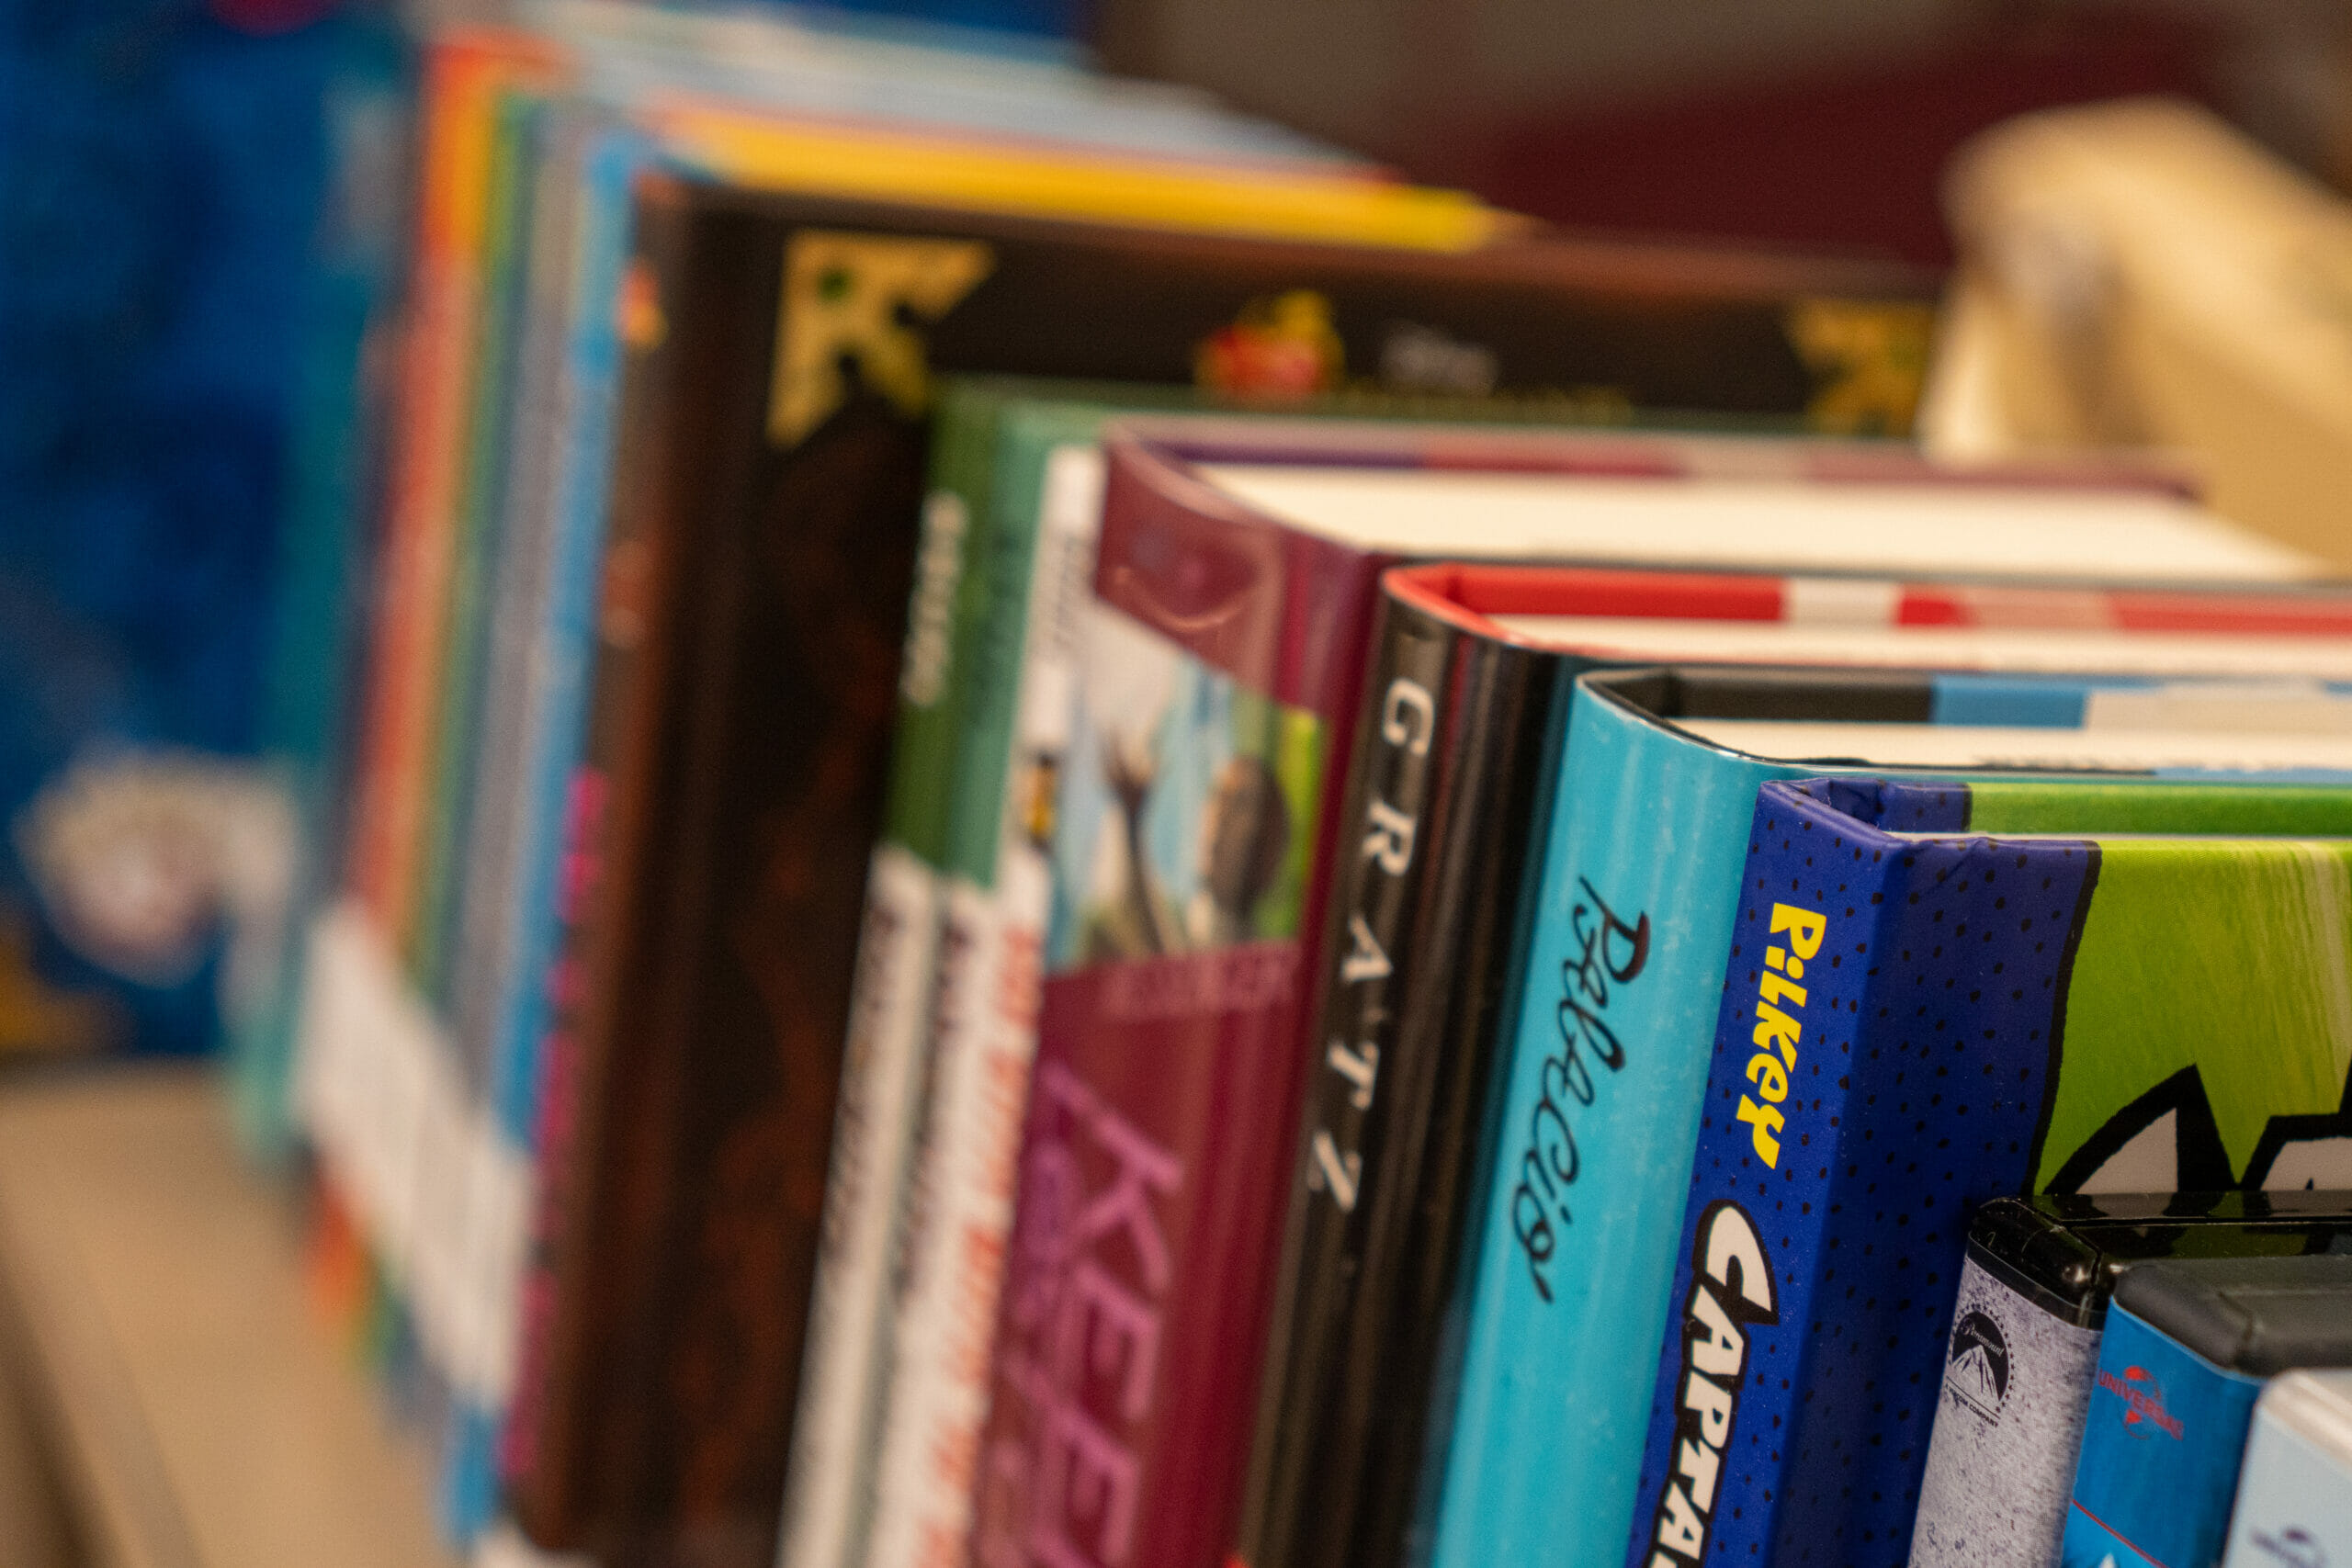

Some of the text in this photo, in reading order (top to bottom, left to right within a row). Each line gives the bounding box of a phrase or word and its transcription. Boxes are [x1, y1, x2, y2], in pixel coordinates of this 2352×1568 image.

[1307, 676, 1435, 1213] GRATZ
[1511, 875, 1651, 1304] Palacio
[1648, 1203, 1774, 1568] CAPTA
[1959, 1318, 2005, 1358] Paramount
[1969, 1404, 1999, 1428] COMPANY
